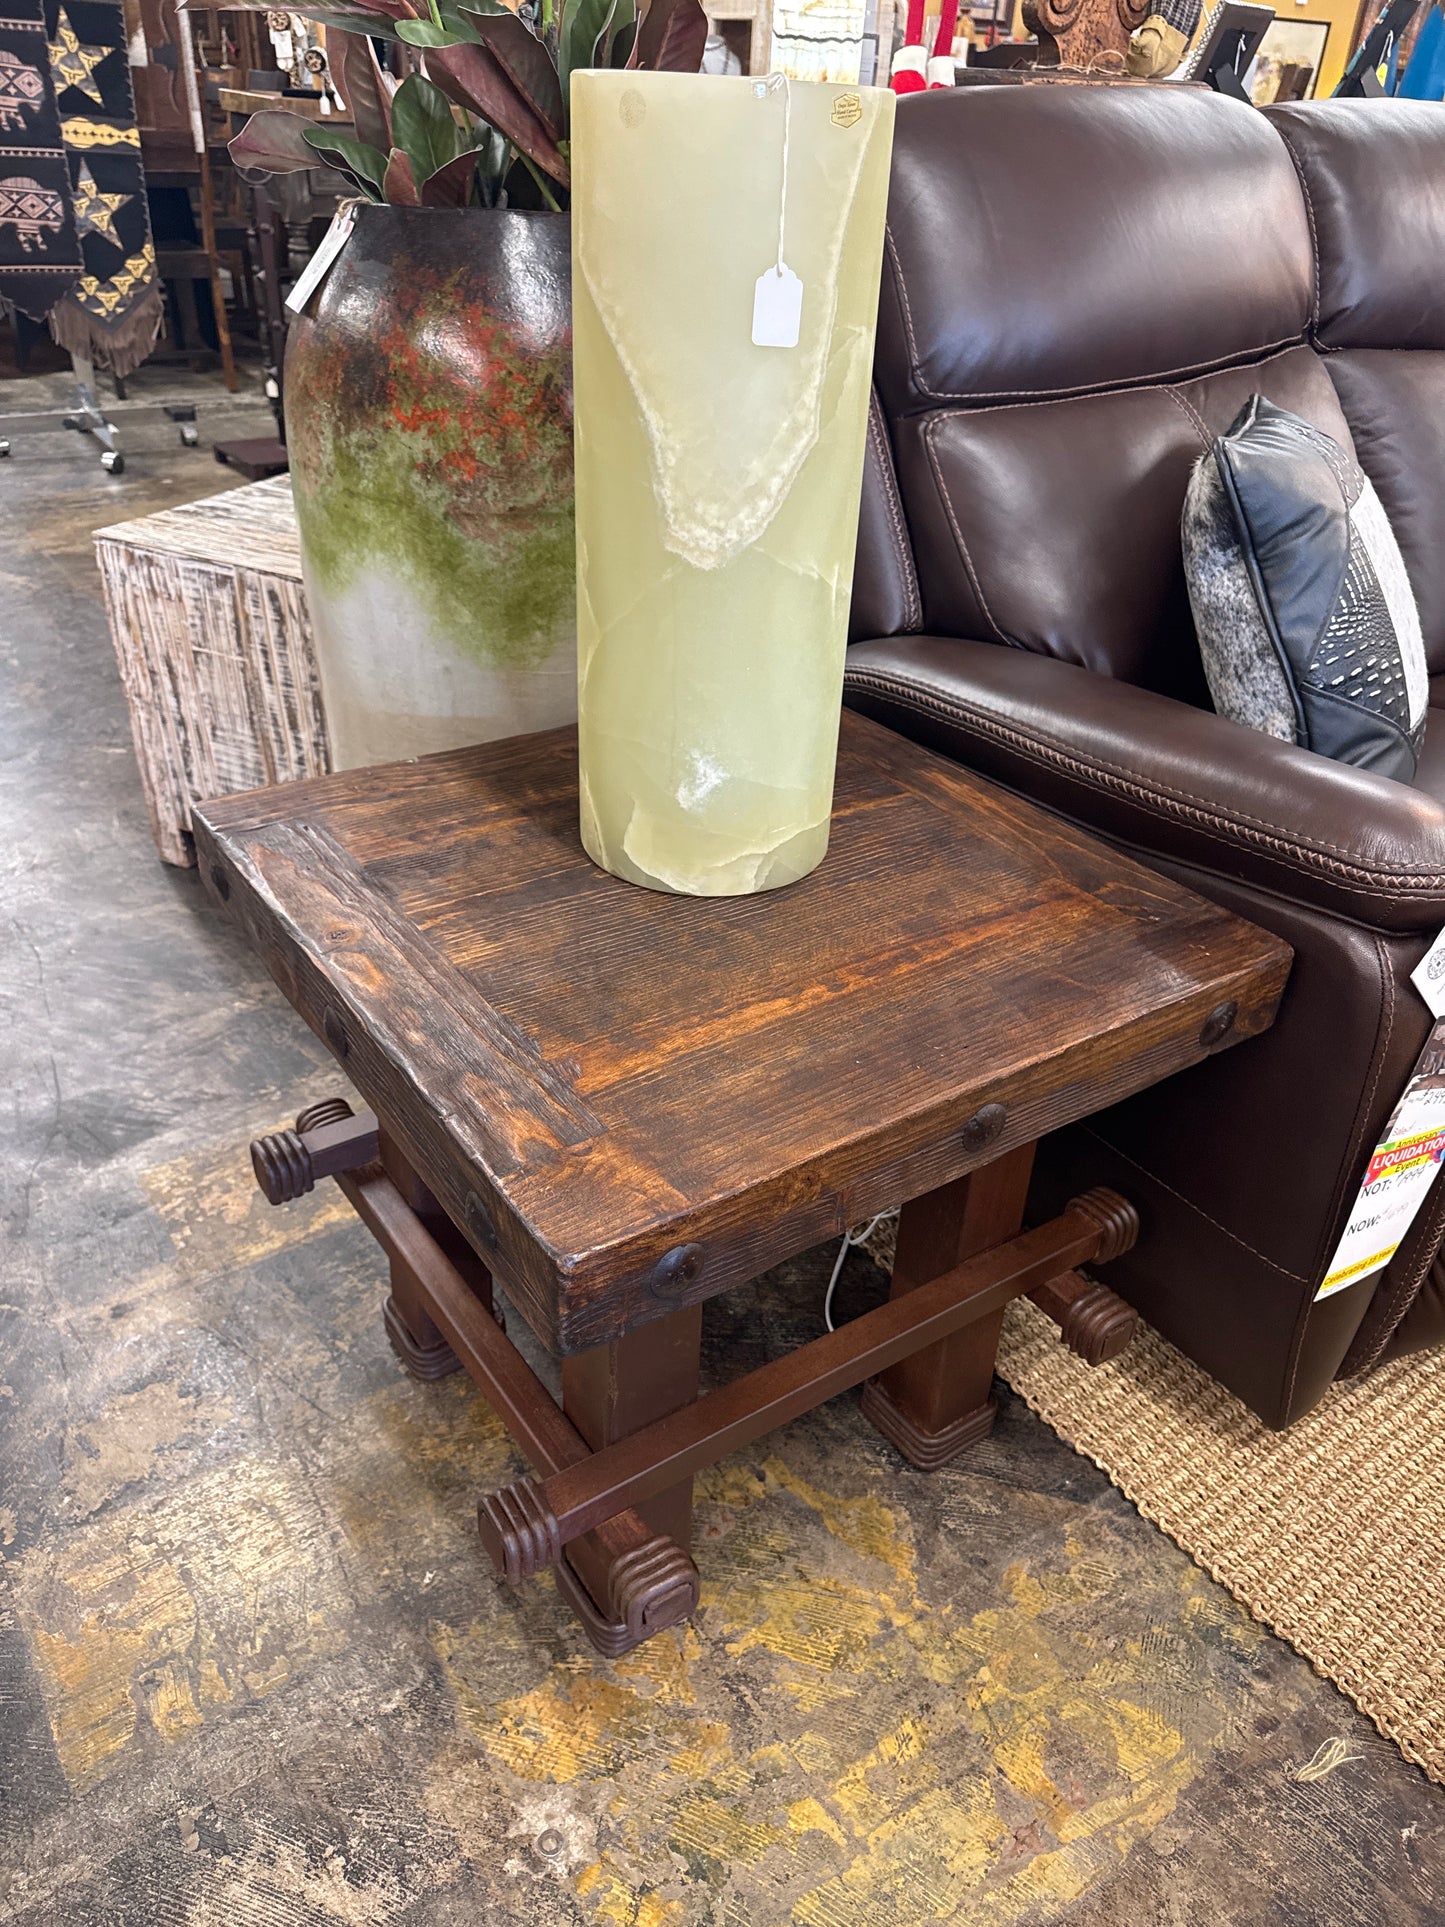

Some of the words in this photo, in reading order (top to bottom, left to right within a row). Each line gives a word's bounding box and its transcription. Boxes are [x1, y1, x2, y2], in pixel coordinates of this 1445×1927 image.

[1397, 1131, 1439, 1148] Anniversary
[1395, 1157, 1421, 1173] Event
[1361, 1179, 1392, 1199] NOT:
[1347, 1214, 1381, 1237] NOW:
[1323, 1261, 1368, 1287] Celebrating
